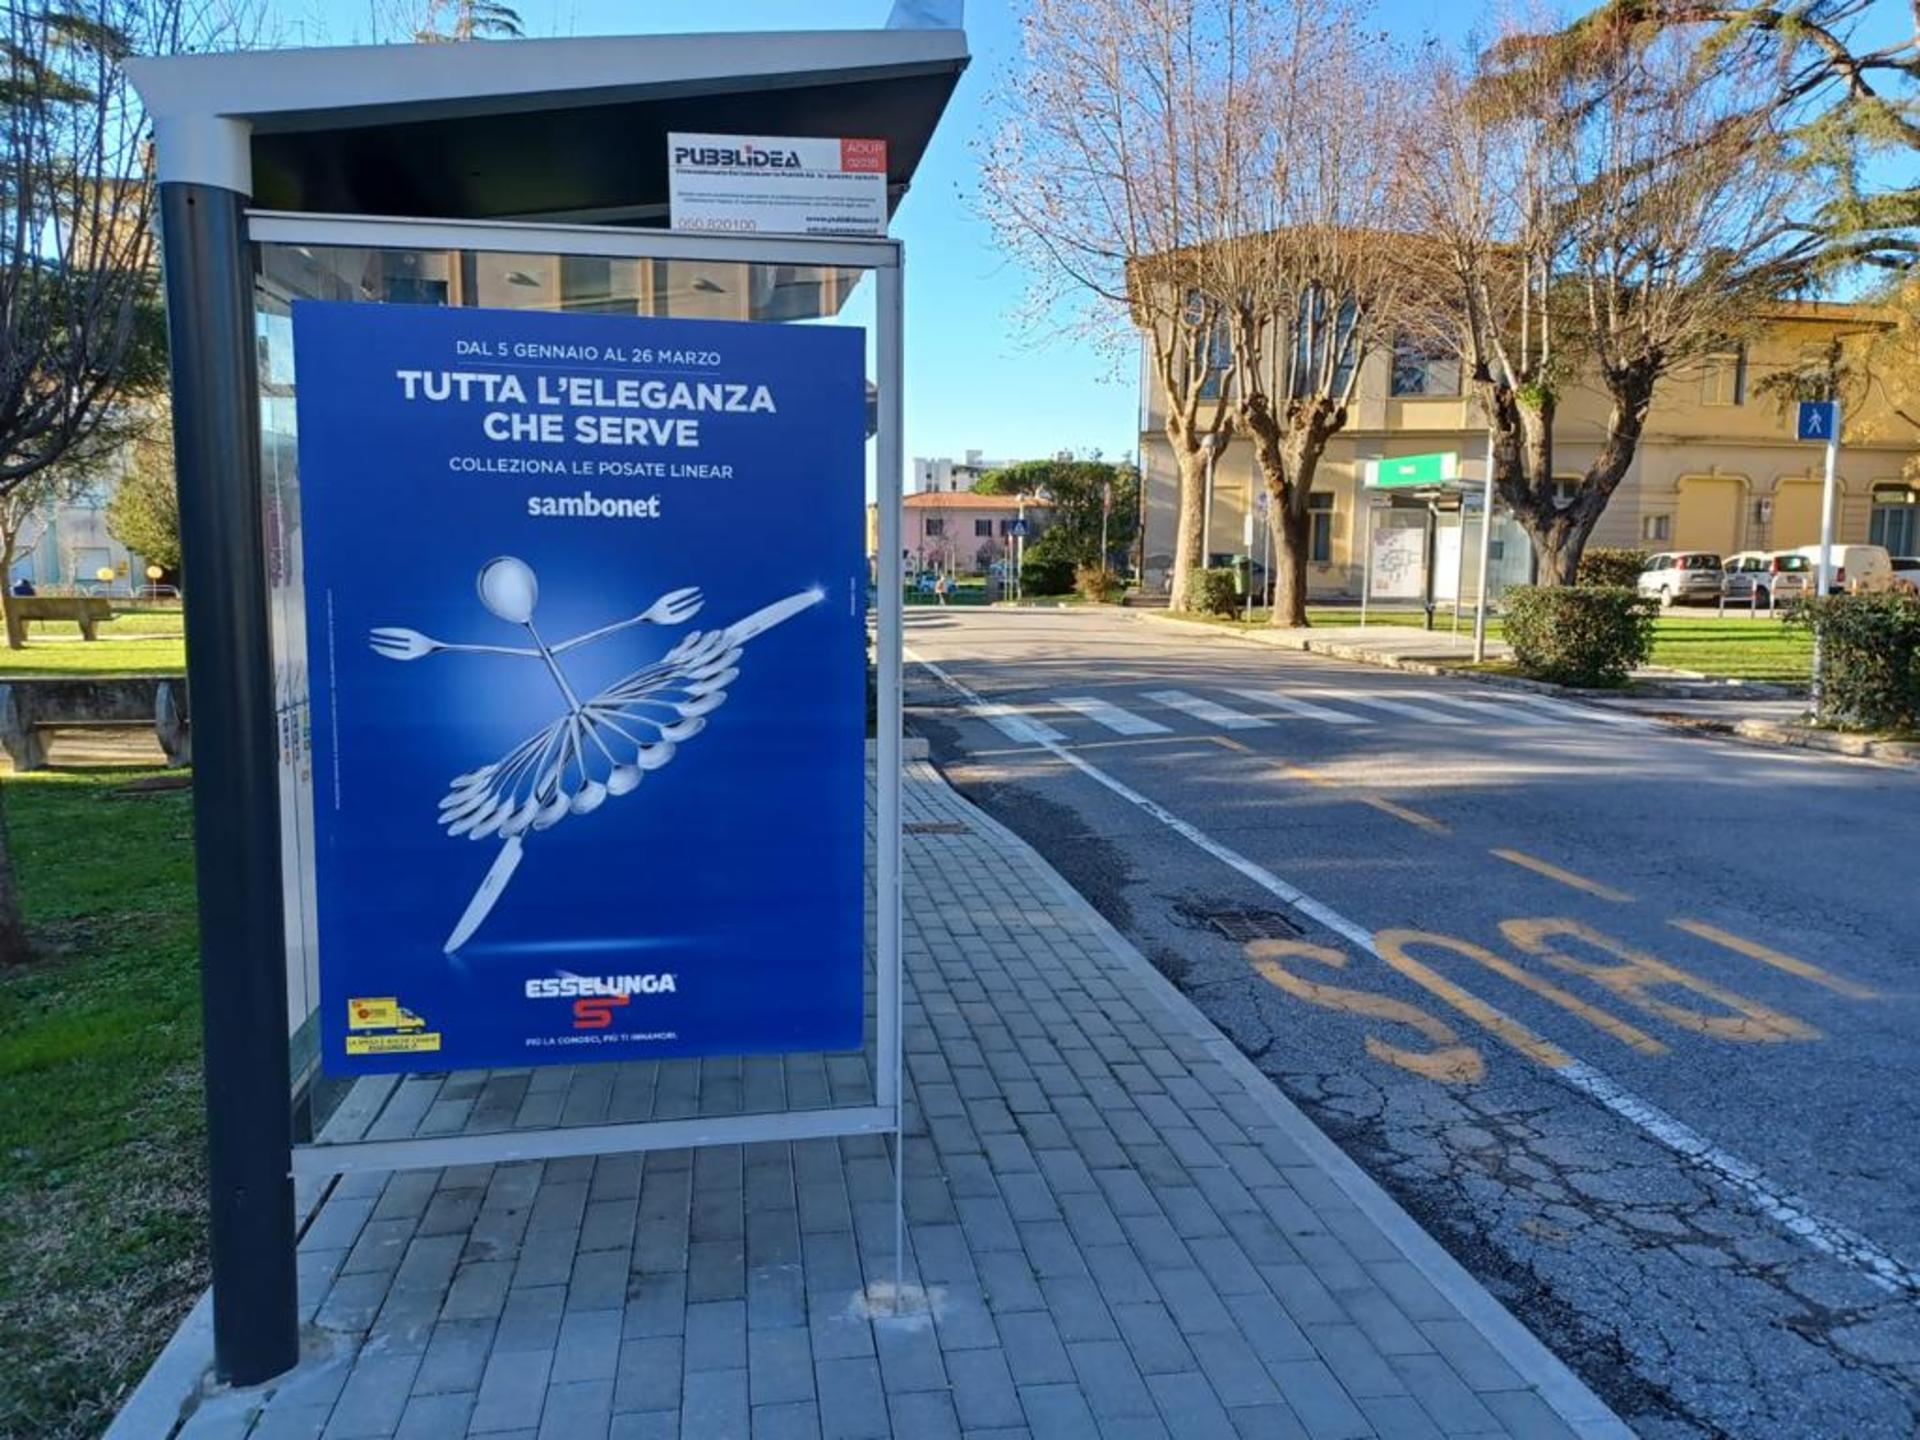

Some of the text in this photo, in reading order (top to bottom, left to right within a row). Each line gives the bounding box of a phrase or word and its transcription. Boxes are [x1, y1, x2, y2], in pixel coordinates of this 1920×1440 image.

[457, 341, 720, 365] DAL 5 GENNAIO AL 26 MARZO
[397, 370, 526, 402] TUTTA
[483, 412, 699, 446] CHE SERVE
[450, 457, 732, 478] COLLEZIONA LE POSATE LINEAR
[528, 492, 660, 517] sambonet
[525, 974, 676, 998] ESSELUNGA
[1242, 918, 1825, 1086] BUS
